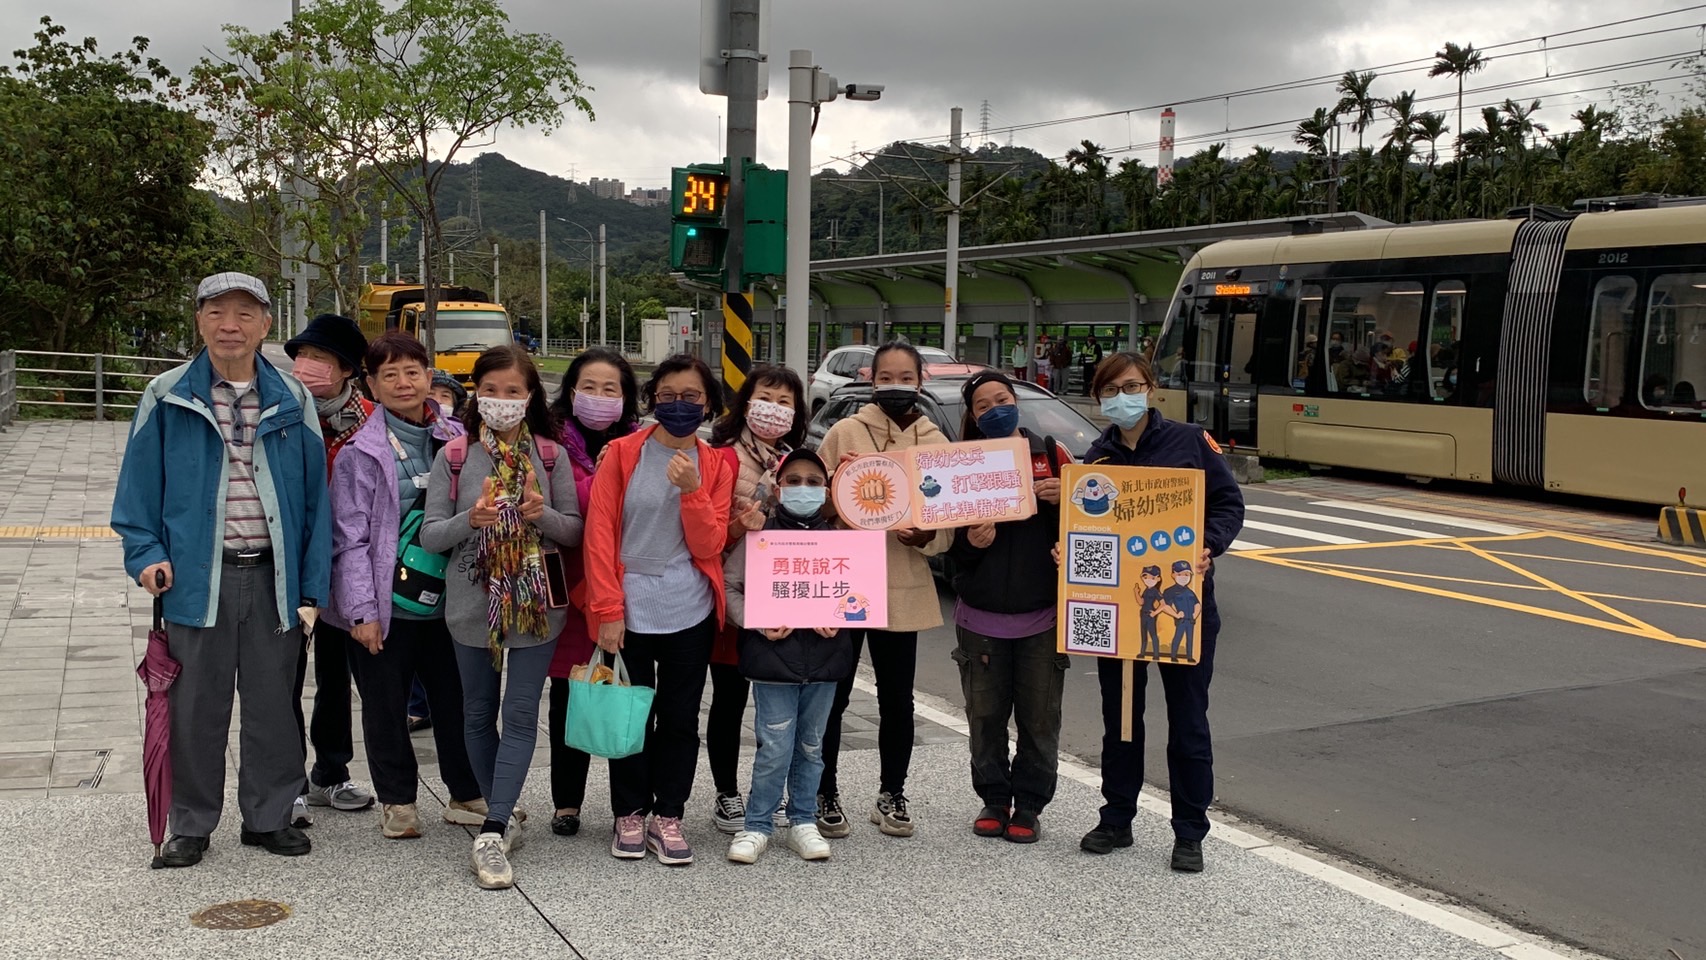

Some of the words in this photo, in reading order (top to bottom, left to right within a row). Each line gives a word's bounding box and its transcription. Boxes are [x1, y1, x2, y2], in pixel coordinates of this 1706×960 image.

[684, 176, 714, 212] 34
[1598, 252, 1629, 264] 2012
[1201, 271, 1216, 280] 2011
[916, 447, 984, 469] 婦幼尖兵
[952, 470, 1022, 493] 打擊跟騷
[1121, 478, 1189, 494] 新北市政府警察局
[921, 494, 1026, 522] 新北準備好了
[1113, 488, 1193, 522] 婦幼警察隊
[1073, 524, 1112, 532] Facebook
[772, 557, 850, 575] 勇敢說不
[772, 581, 850, 599] 騷擾止步
[1072, 591, 1112, 600] Instagram
